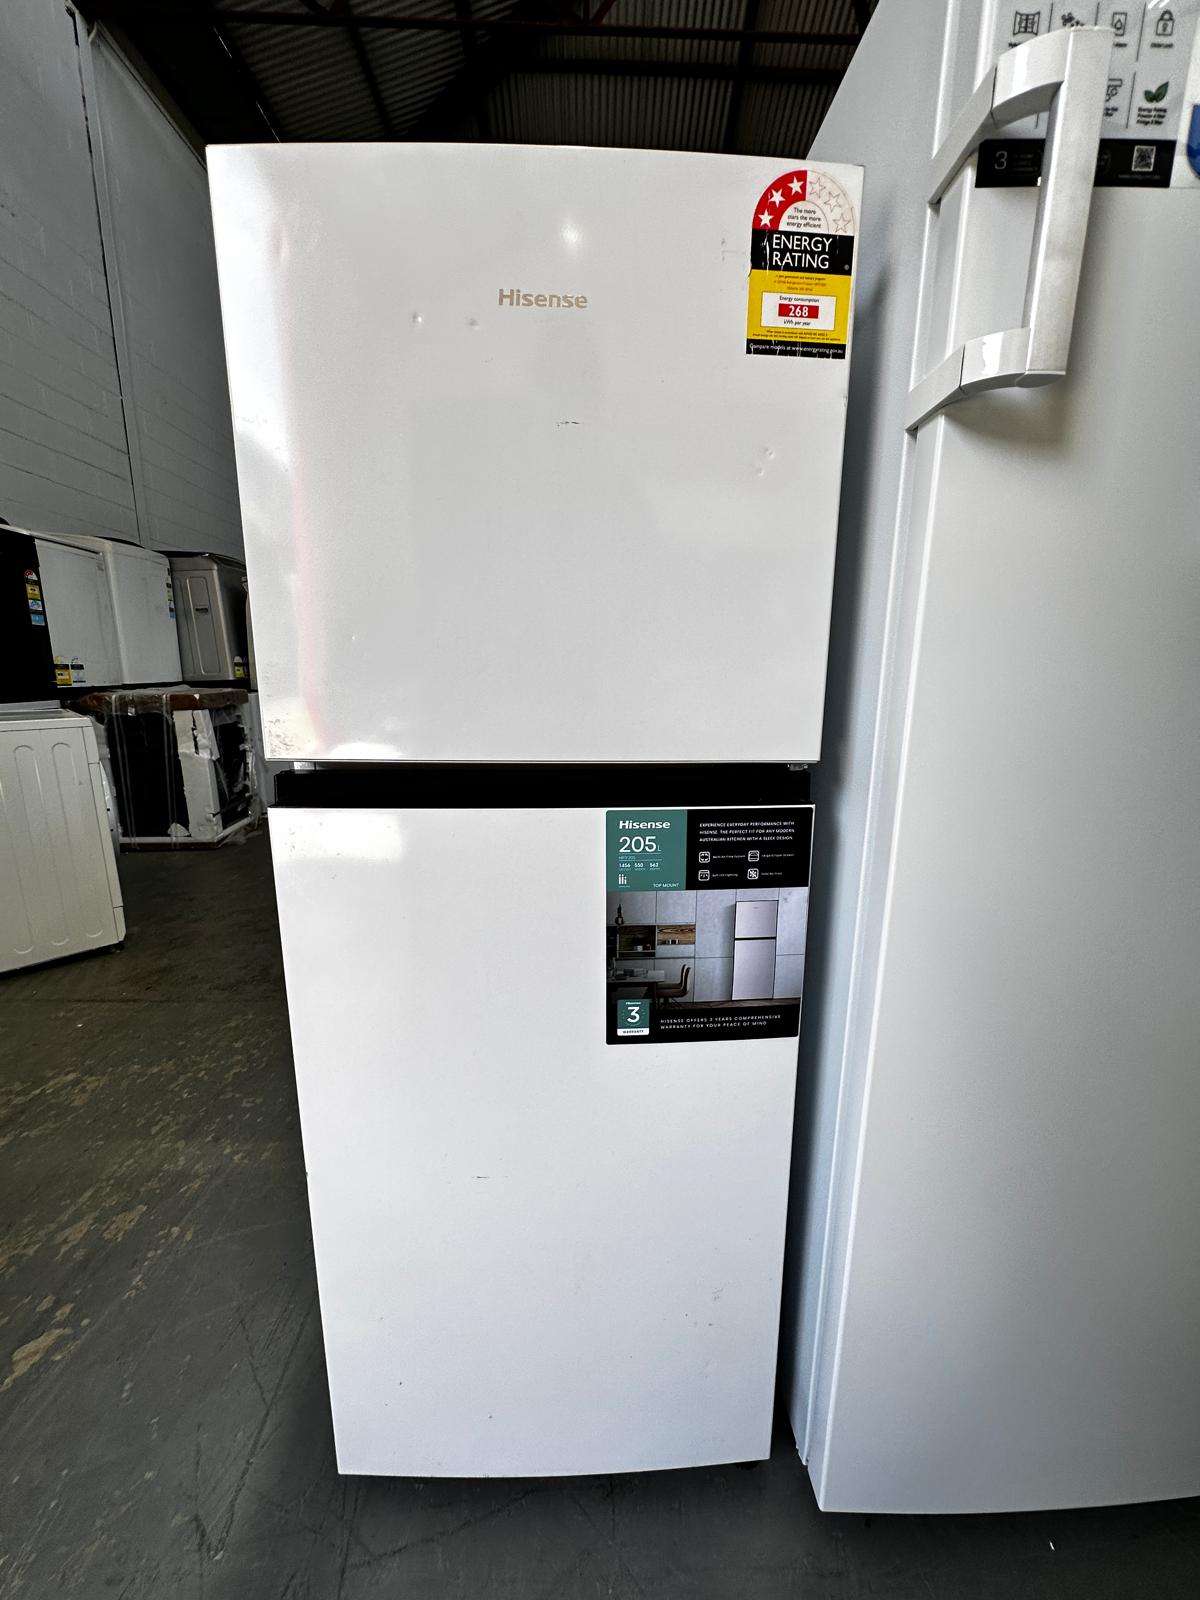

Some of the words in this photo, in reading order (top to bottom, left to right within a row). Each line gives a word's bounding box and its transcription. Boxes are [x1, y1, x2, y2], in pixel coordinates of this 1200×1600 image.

[994, 151, 1008, 170] 3
[772, 234, 833, 253] ENERGY
[772, 251, 830, 269] RATING
[498, 289, 588, 309] Hisense
[788, 305, 809, 317] 268
[619, 820, 671, 829] Hisense
[627, 1006, 640, 1023] 3
